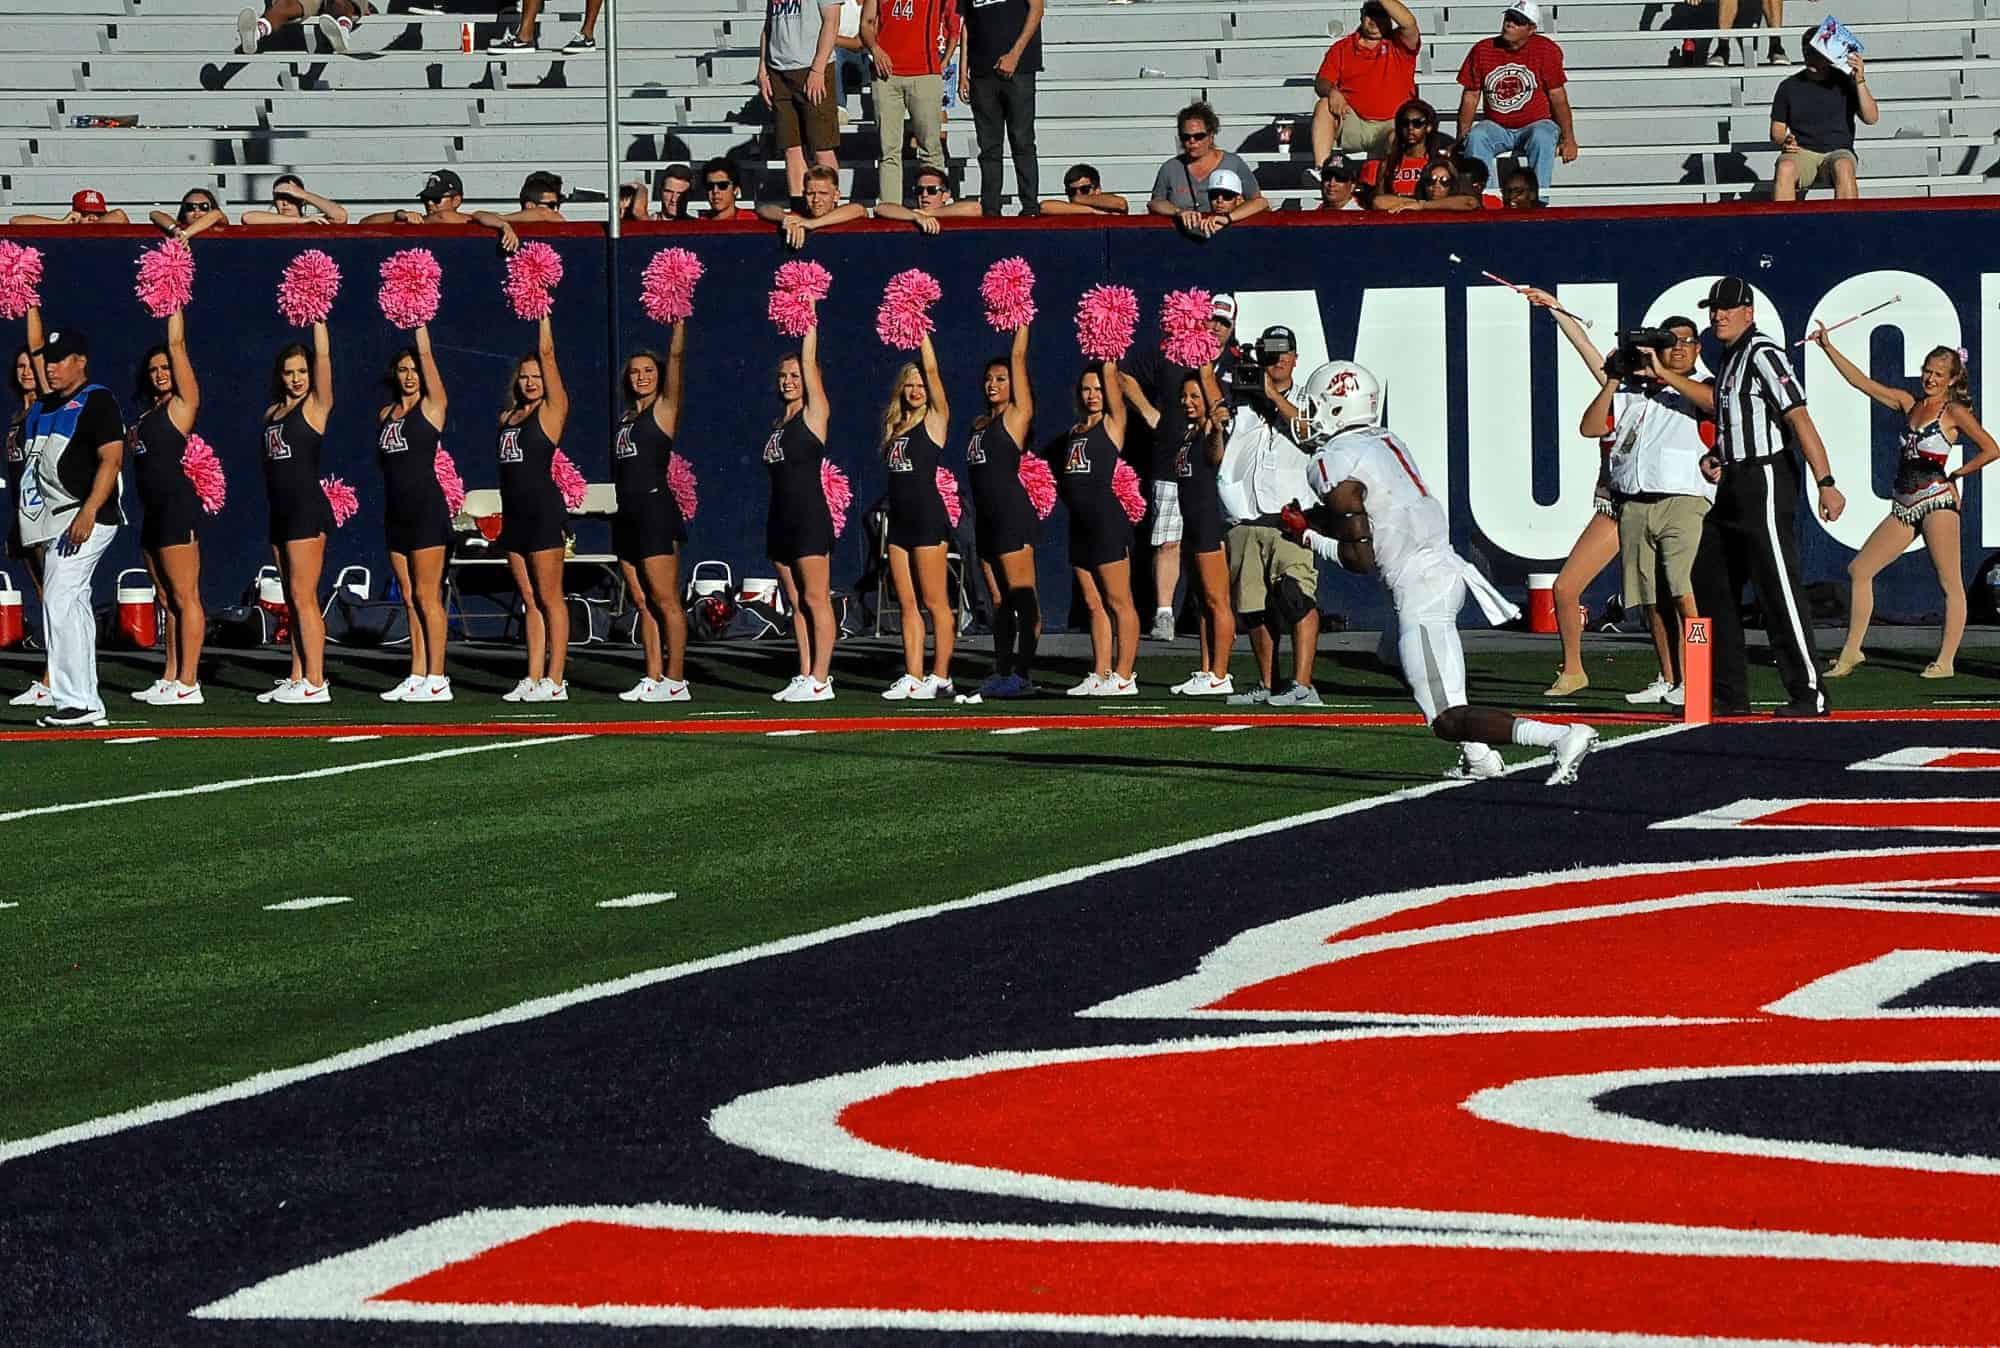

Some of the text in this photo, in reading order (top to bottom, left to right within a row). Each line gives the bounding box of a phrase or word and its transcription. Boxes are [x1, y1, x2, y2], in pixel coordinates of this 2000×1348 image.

[892, 0, 913, 20] 44
[265, 424, 291, 459] A
[380, 418, 408, 454] A
[499, 428, 523, 462] A
[615, 423, 638, 459] A
[888, 437, 913, 472] A
[1064, 438, 1090, 473] A
[1687, 623, 1708, 644] A
